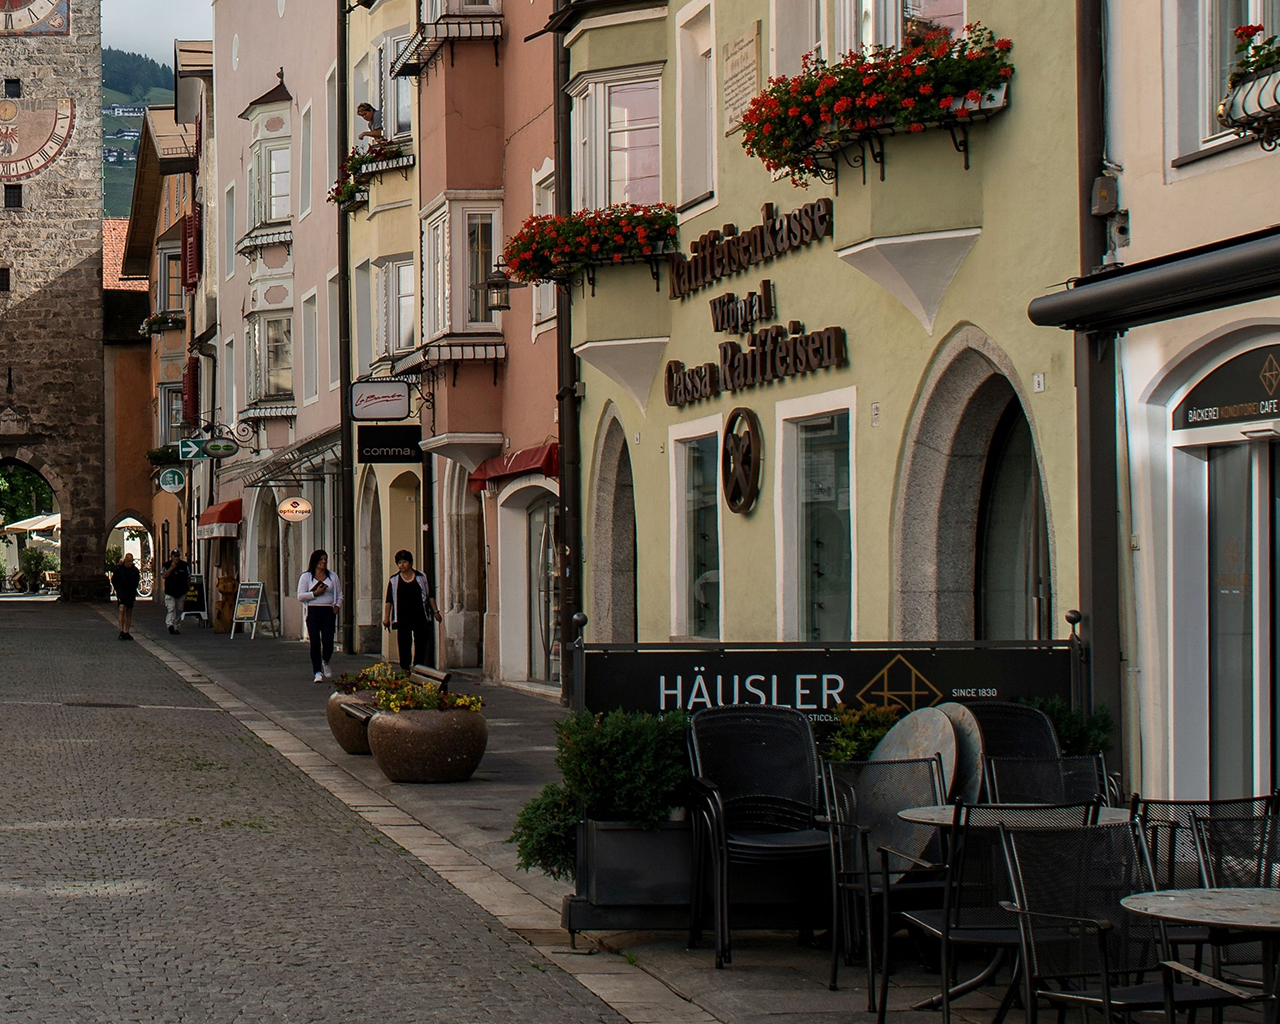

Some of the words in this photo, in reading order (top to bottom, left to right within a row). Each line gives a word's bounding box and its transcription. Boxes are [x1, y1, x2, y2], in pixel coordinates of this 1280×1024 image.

[668, 197, 833, 300] Raiffeisenkasse
[709, 279, 774, 335] Wipptal
[664, 360, 720, 406] Cassa
[718, 320, 850, 392] Raiffeisen
[659, 666, 845, 710] HÄUSLER
[952, 688, 976, 697] SINCE
[978, 688, 997, 697] 1830
